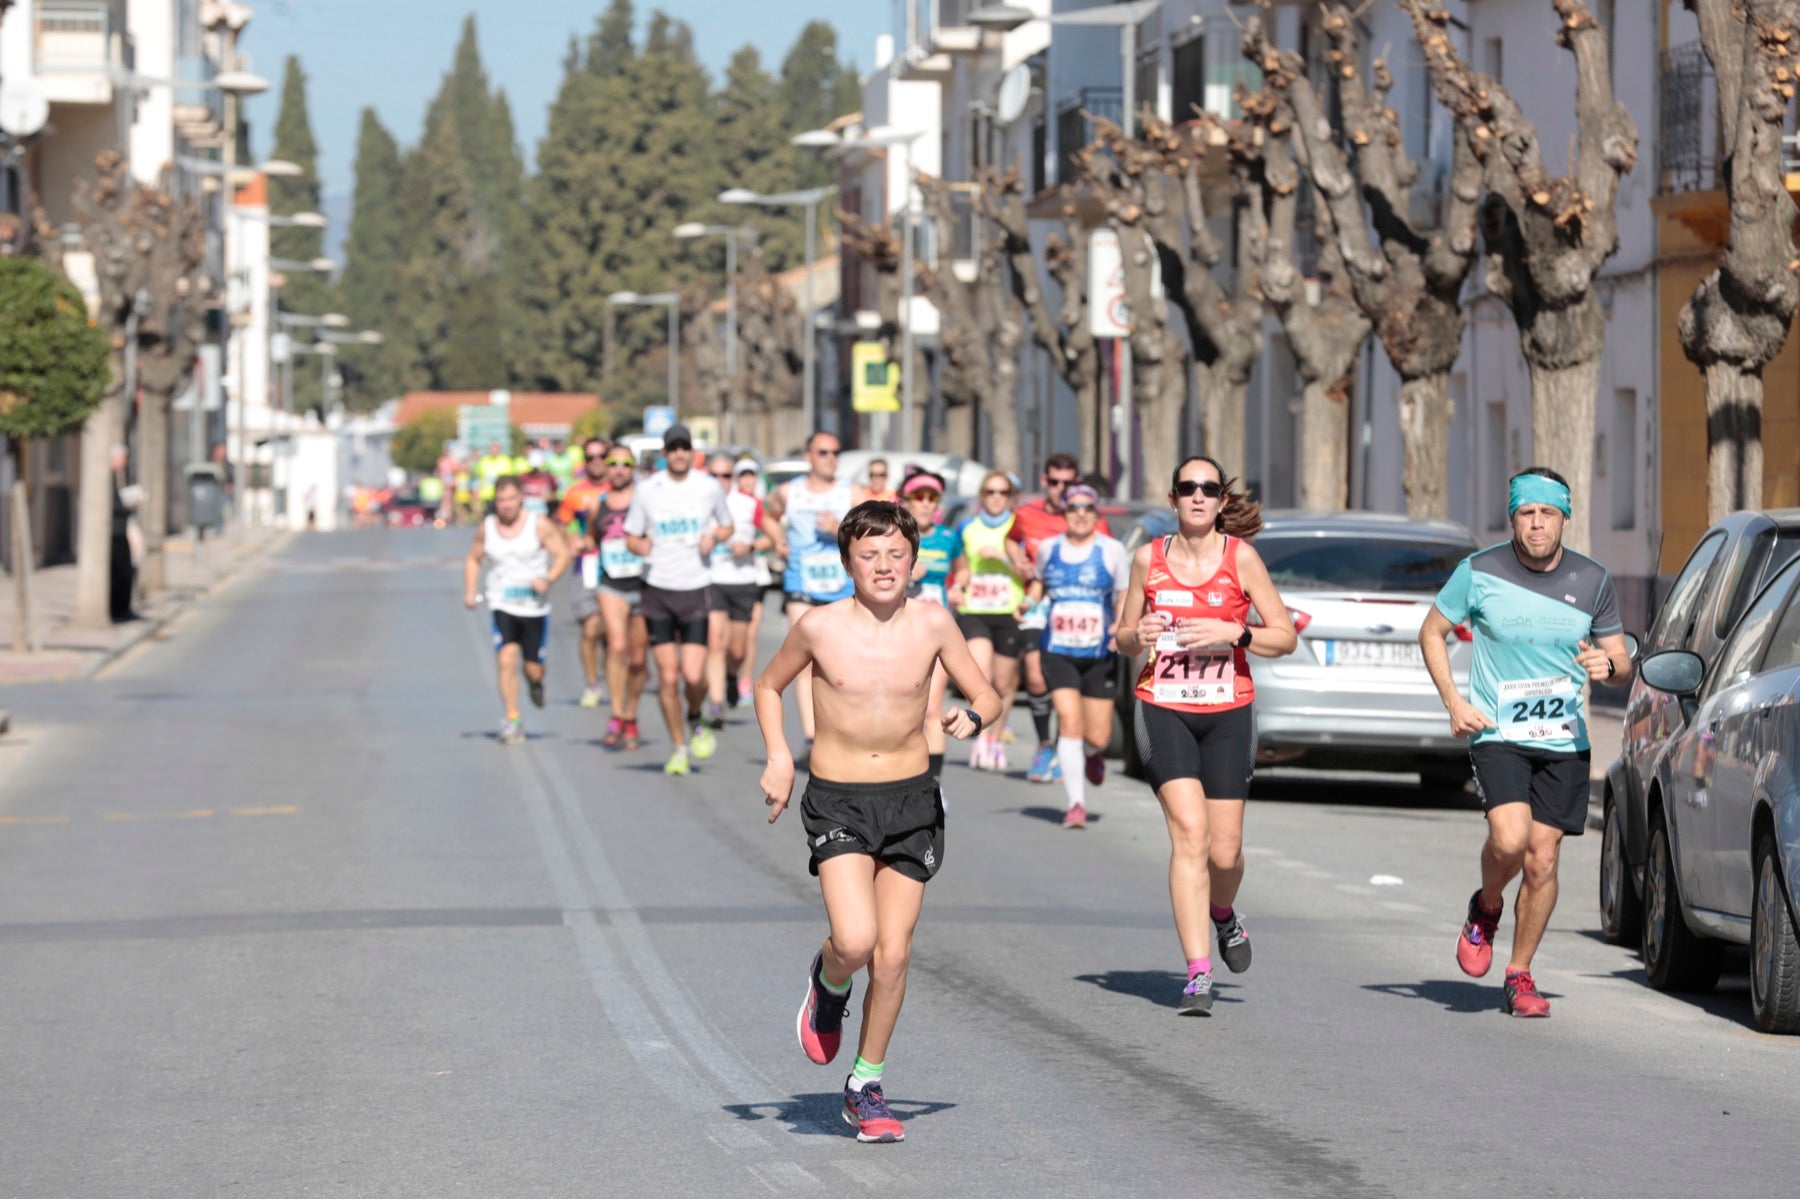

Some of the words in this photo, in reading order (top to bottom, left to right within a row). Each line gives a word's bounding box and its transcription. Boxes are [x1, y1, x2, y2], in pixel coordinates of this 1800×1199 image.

[1054, 615, 1099, 633] 2147
[1160, 654, 1230, 680] 2177
[1512, 697, 1565, 724] 242
